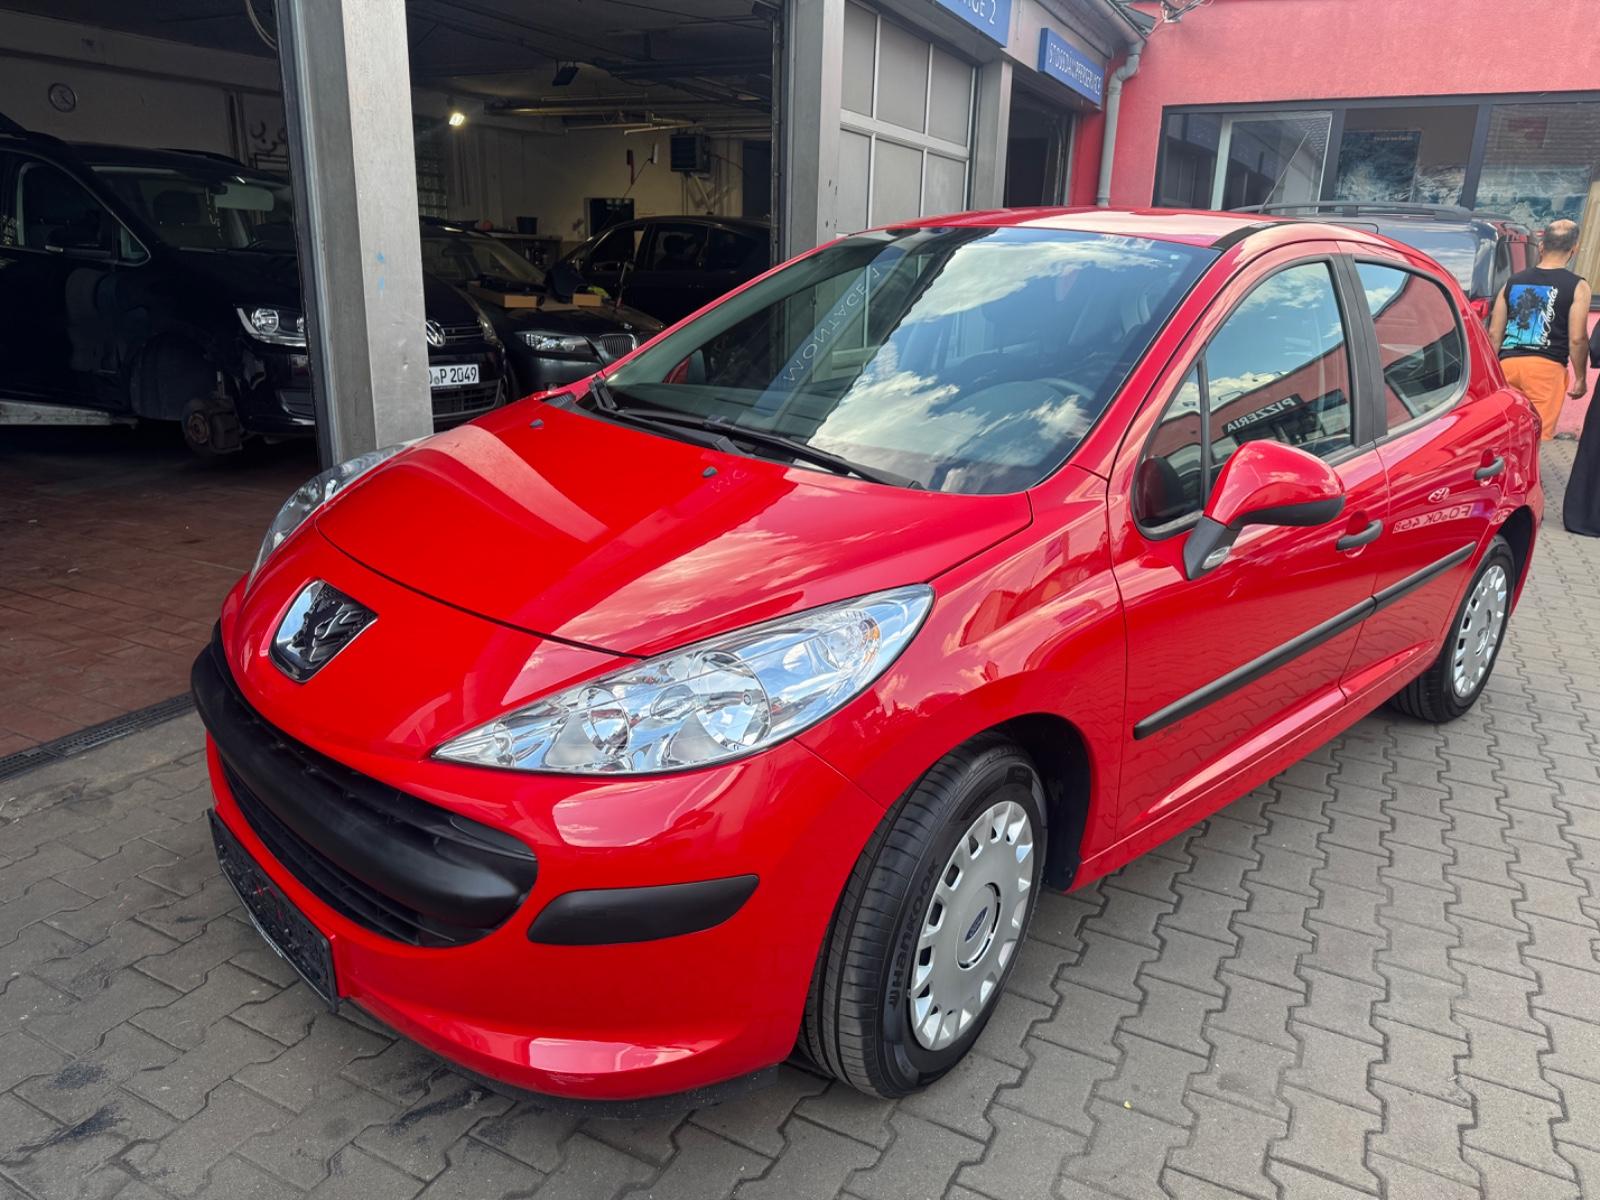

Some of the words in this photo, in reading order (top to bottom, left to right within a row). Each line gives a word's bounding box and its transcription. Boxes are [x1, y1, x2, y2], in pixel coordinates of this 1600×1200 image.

[988, 0, 995, 25] 2
[439, 368, 448, 384] P
[450, 366, 477, 383] 2049
